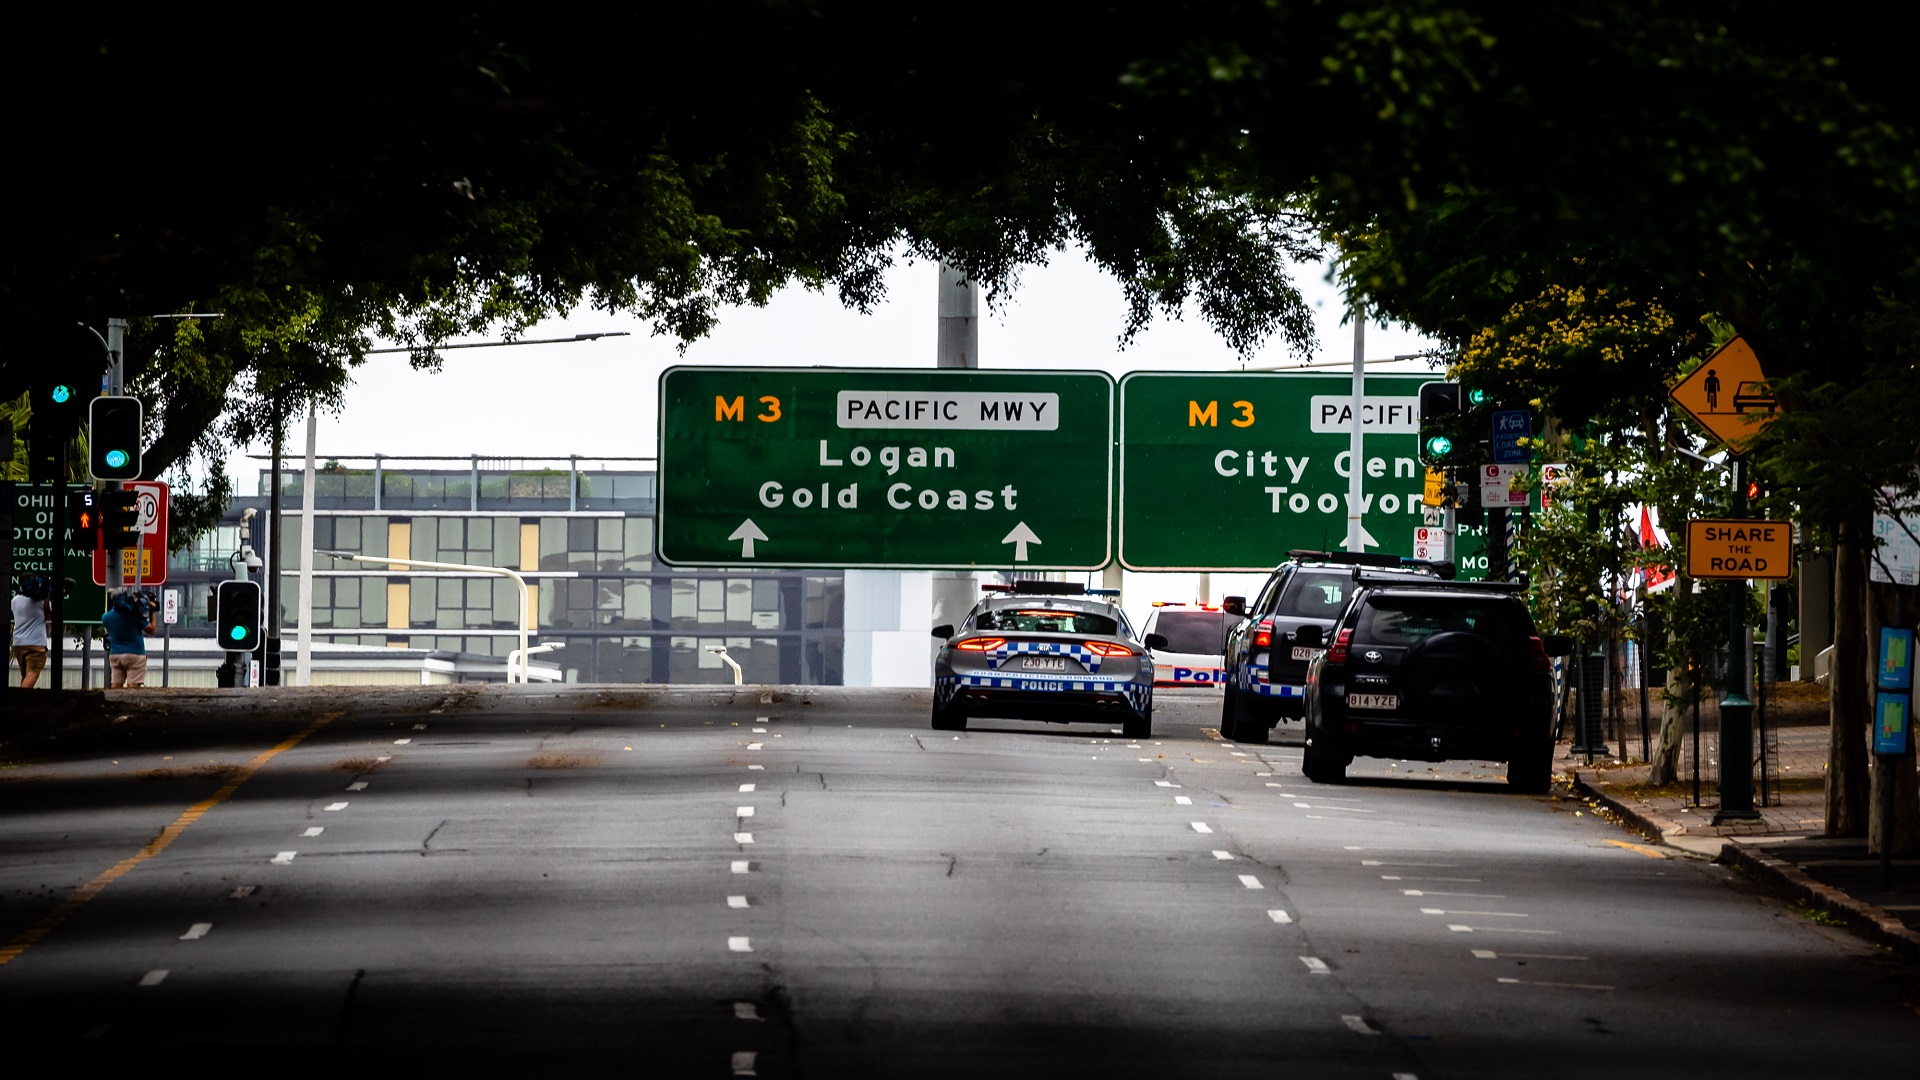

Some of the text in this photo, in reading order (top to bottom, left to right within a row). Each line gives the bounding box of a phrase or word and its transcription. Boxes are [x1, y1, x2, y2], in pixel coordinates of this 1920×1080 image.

[848, 400, 1047, 422] PACIFIC MWY
[1321, 404, 1417, 425] PACIFI
[820, 439, 955, 476] Logan
[1214, 449, 1310, 484] City
[758, 481, 1018, 511] Gold Coast
[1264, 486, 1427, 515] Toowon
[1704, 527, 1776, 542] SHARE
[1727, 544, 1752, 555] THE
[1710, 557, 1768, 572] ROAD
[1021, 680, 1064, 692] POLICE
